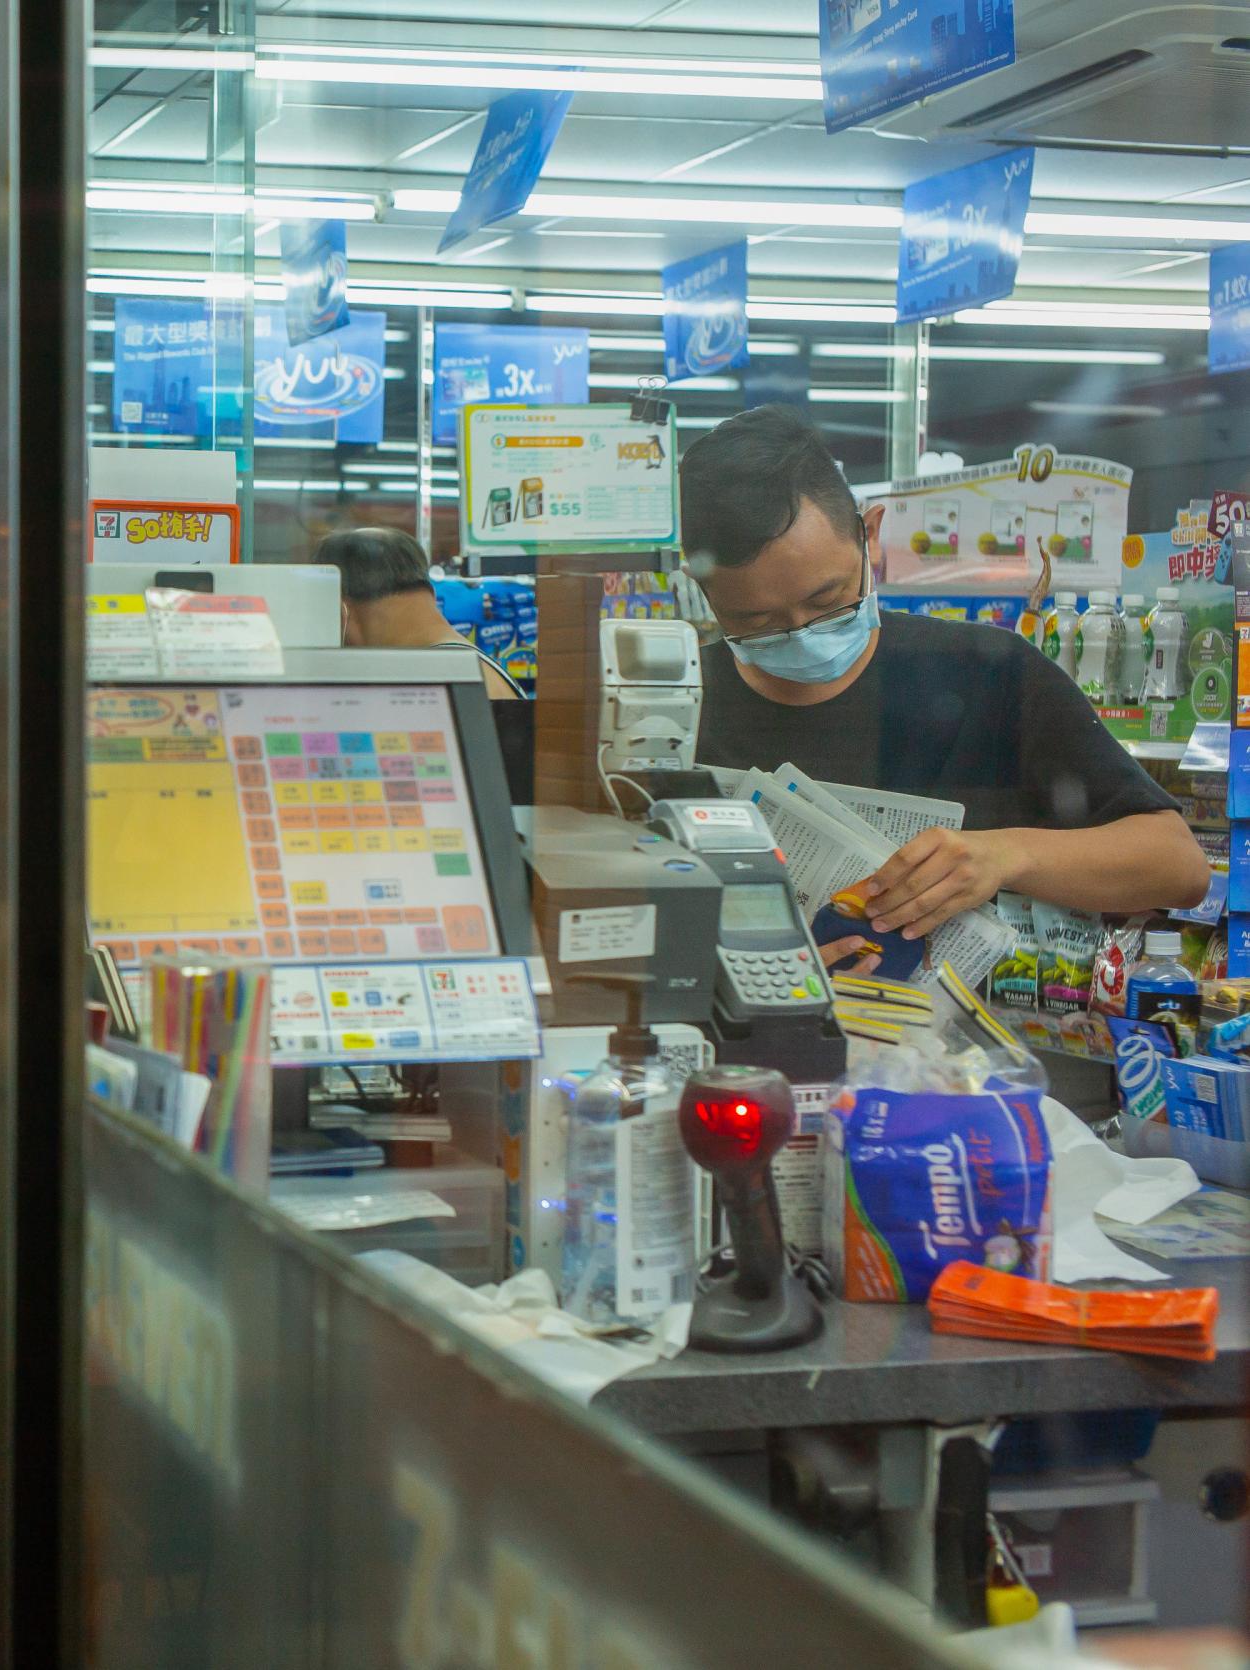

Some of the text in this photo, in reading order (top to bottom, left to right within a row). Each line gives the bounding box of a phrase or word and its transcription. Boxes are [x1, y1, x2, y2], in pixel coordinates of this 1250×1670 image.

[553, 343, 583, 366] yuu
[270, 352, 347, 402] yuu
[1017, 448, 1054, 483] 10
[550, 502, 581, 517] $55
[918, 1142, 972, 1260] Tempo
